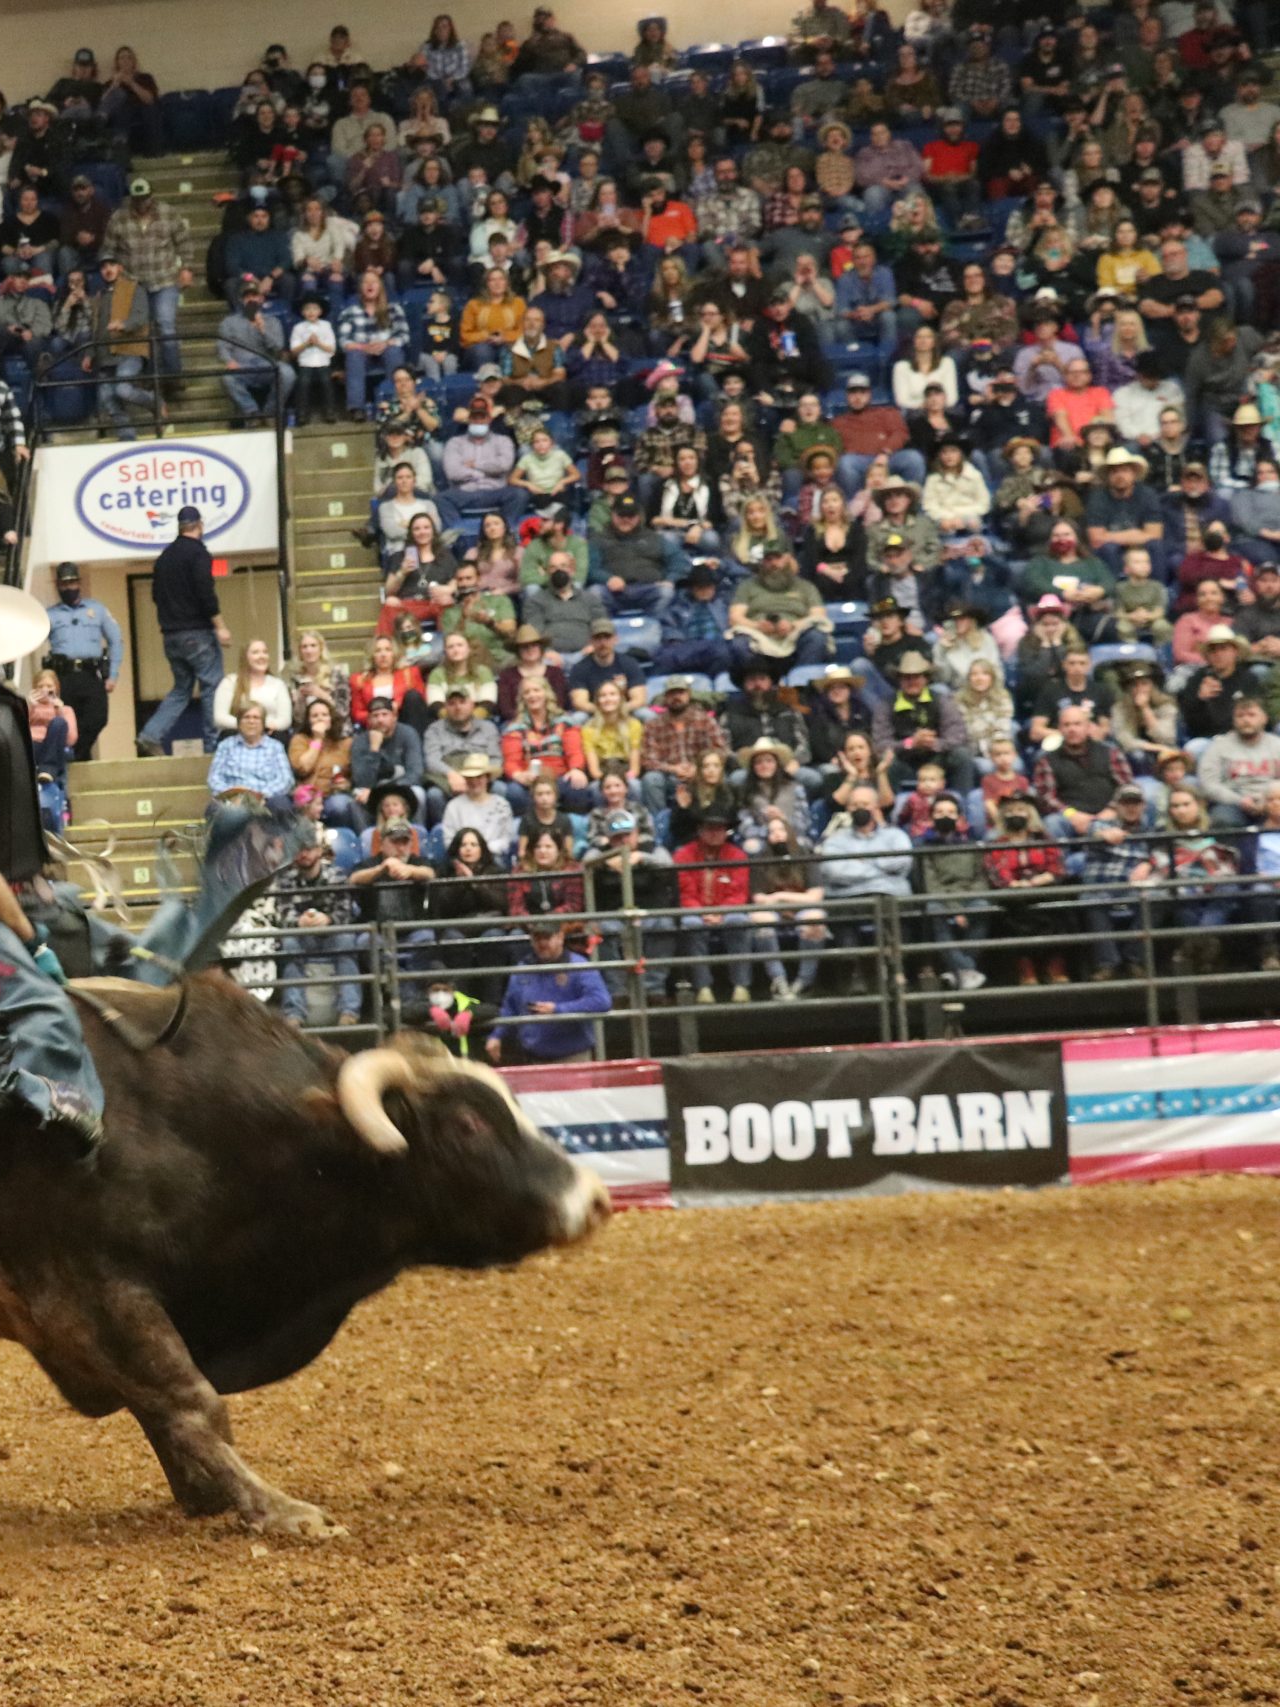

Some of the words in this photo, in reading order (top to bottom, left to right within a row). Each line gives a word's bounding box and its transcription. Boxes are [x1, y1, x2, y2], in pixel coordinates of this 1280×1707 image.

[119, 457, 205, 483] salem
[99, 480, 227, 510] catering
[682, 1098, 862, 1166] BOOT
[869, 1089, 1054, 1156] BARN
